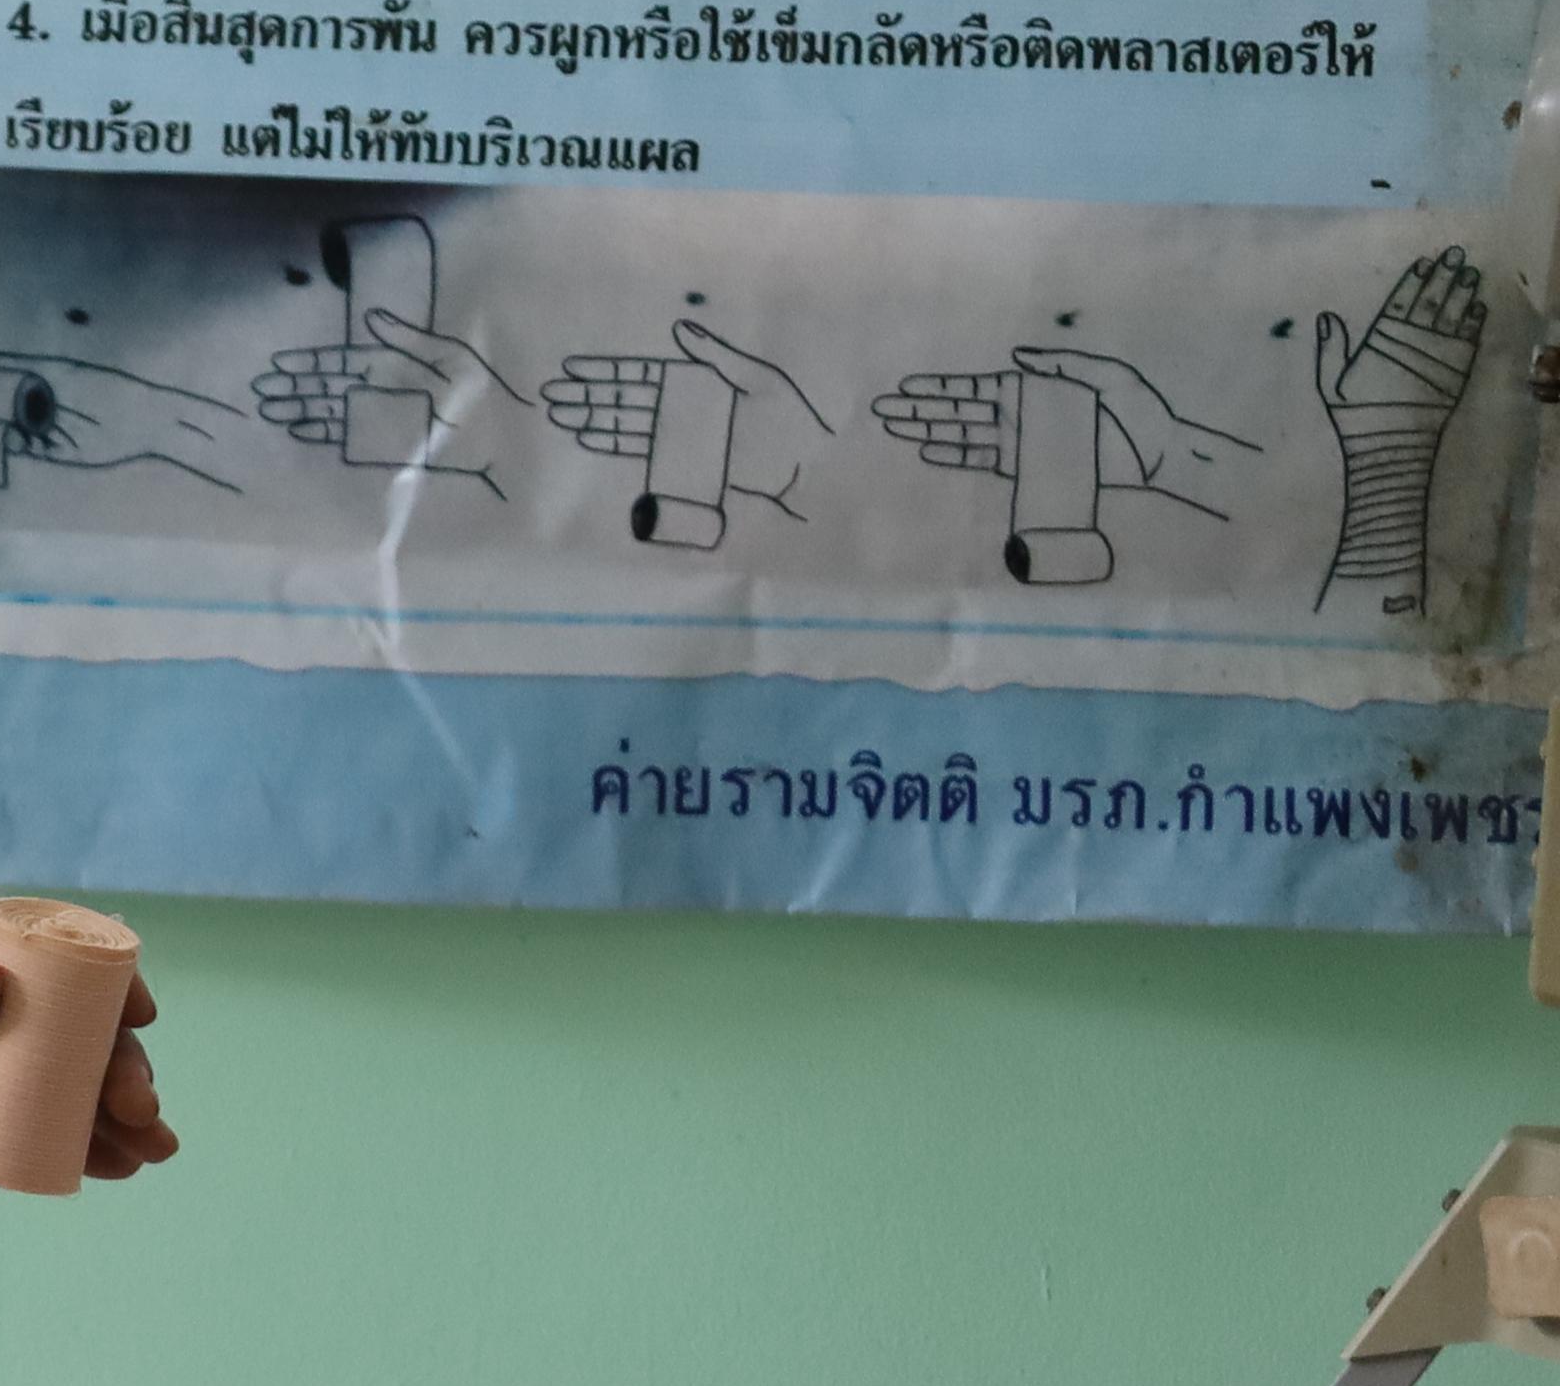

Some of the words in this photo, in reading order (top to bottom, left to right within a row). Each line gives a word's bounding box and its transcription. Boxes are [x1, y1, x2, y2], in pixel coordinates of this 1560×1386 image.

[6, 0, 51, 42] 4.
[464, 3, 1378, 78] ควรผูกหรือใช้เข็มกลัดหรือติดพลาสเตอร์ให้
[5, 96, 192, 155] เรียบร้อย
[222, 102, 701, 173] แต่ไม่ให้ทับบริเวณแผล
[590, 735, 979, 823] ค่ายรามจิตติ
